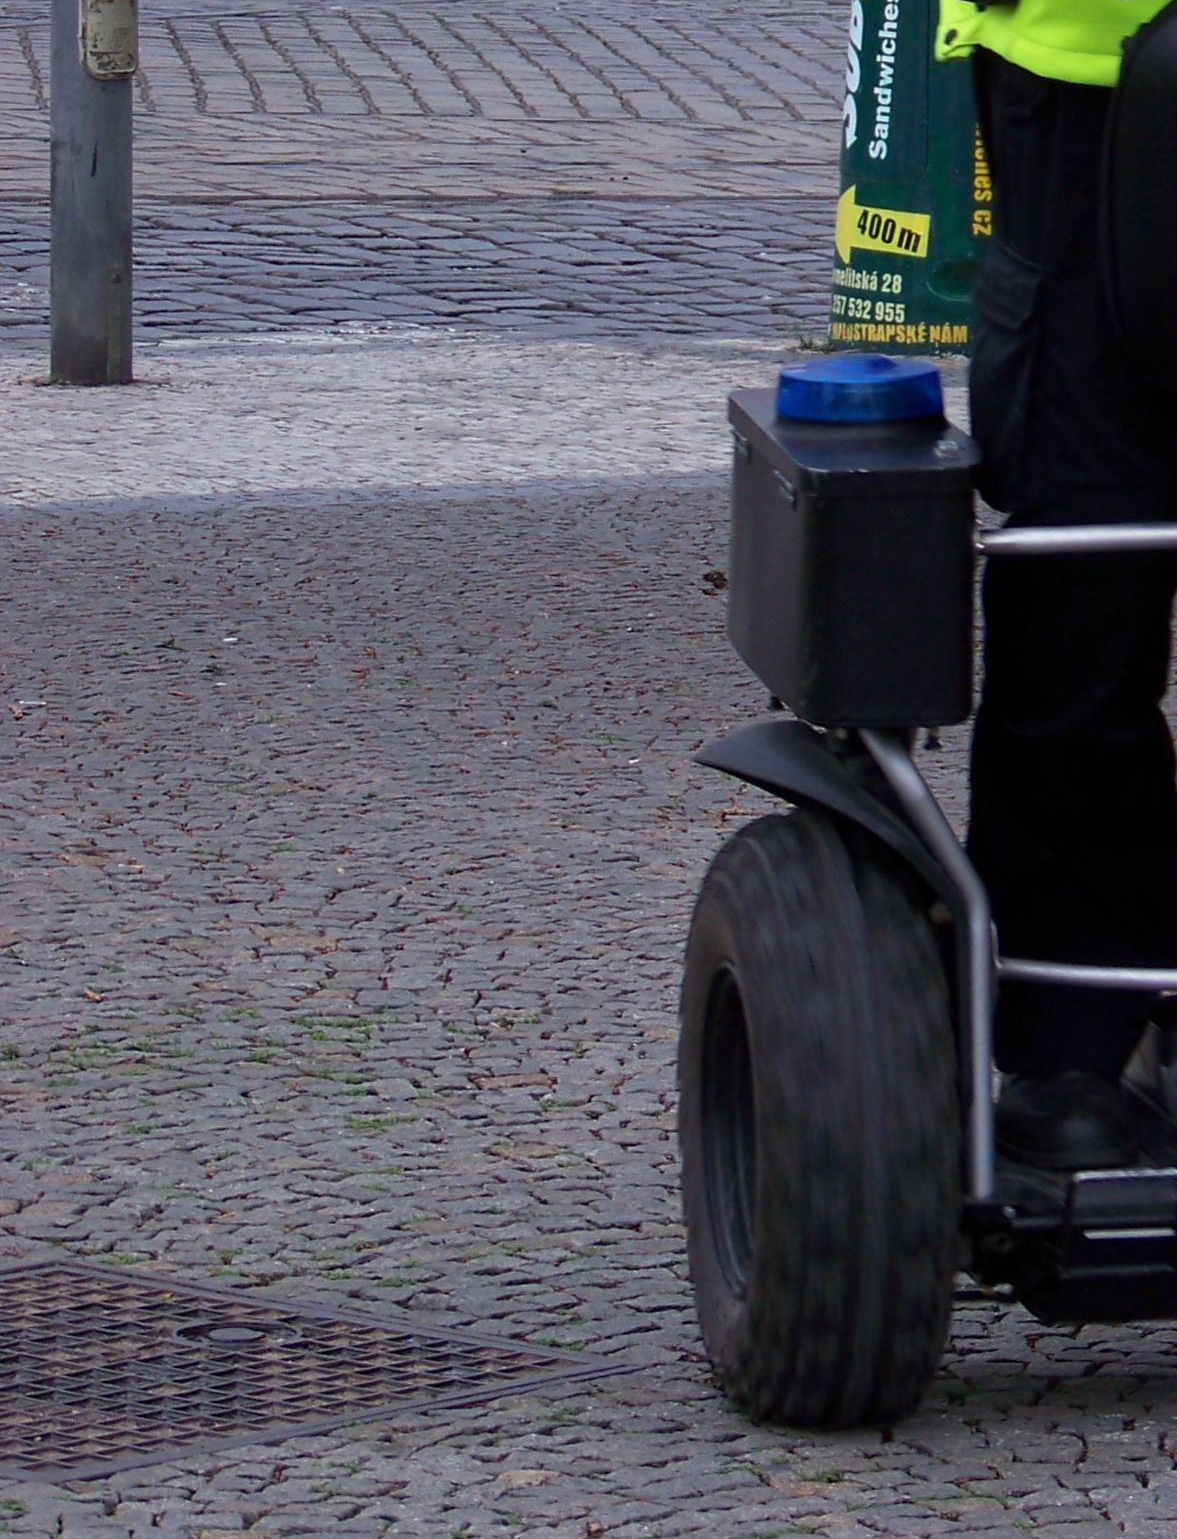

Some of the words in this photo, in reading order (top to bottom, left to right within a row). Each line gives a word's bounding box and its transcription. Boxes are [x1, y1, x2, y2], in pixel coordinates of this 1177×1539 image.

[857, 208, 897, 245] 400
[897, 226, 922, 254] m
[881, 273, 903, 295] 28
[847, 297, 872, 320] 532
[874, 301, 906, 323] 955
